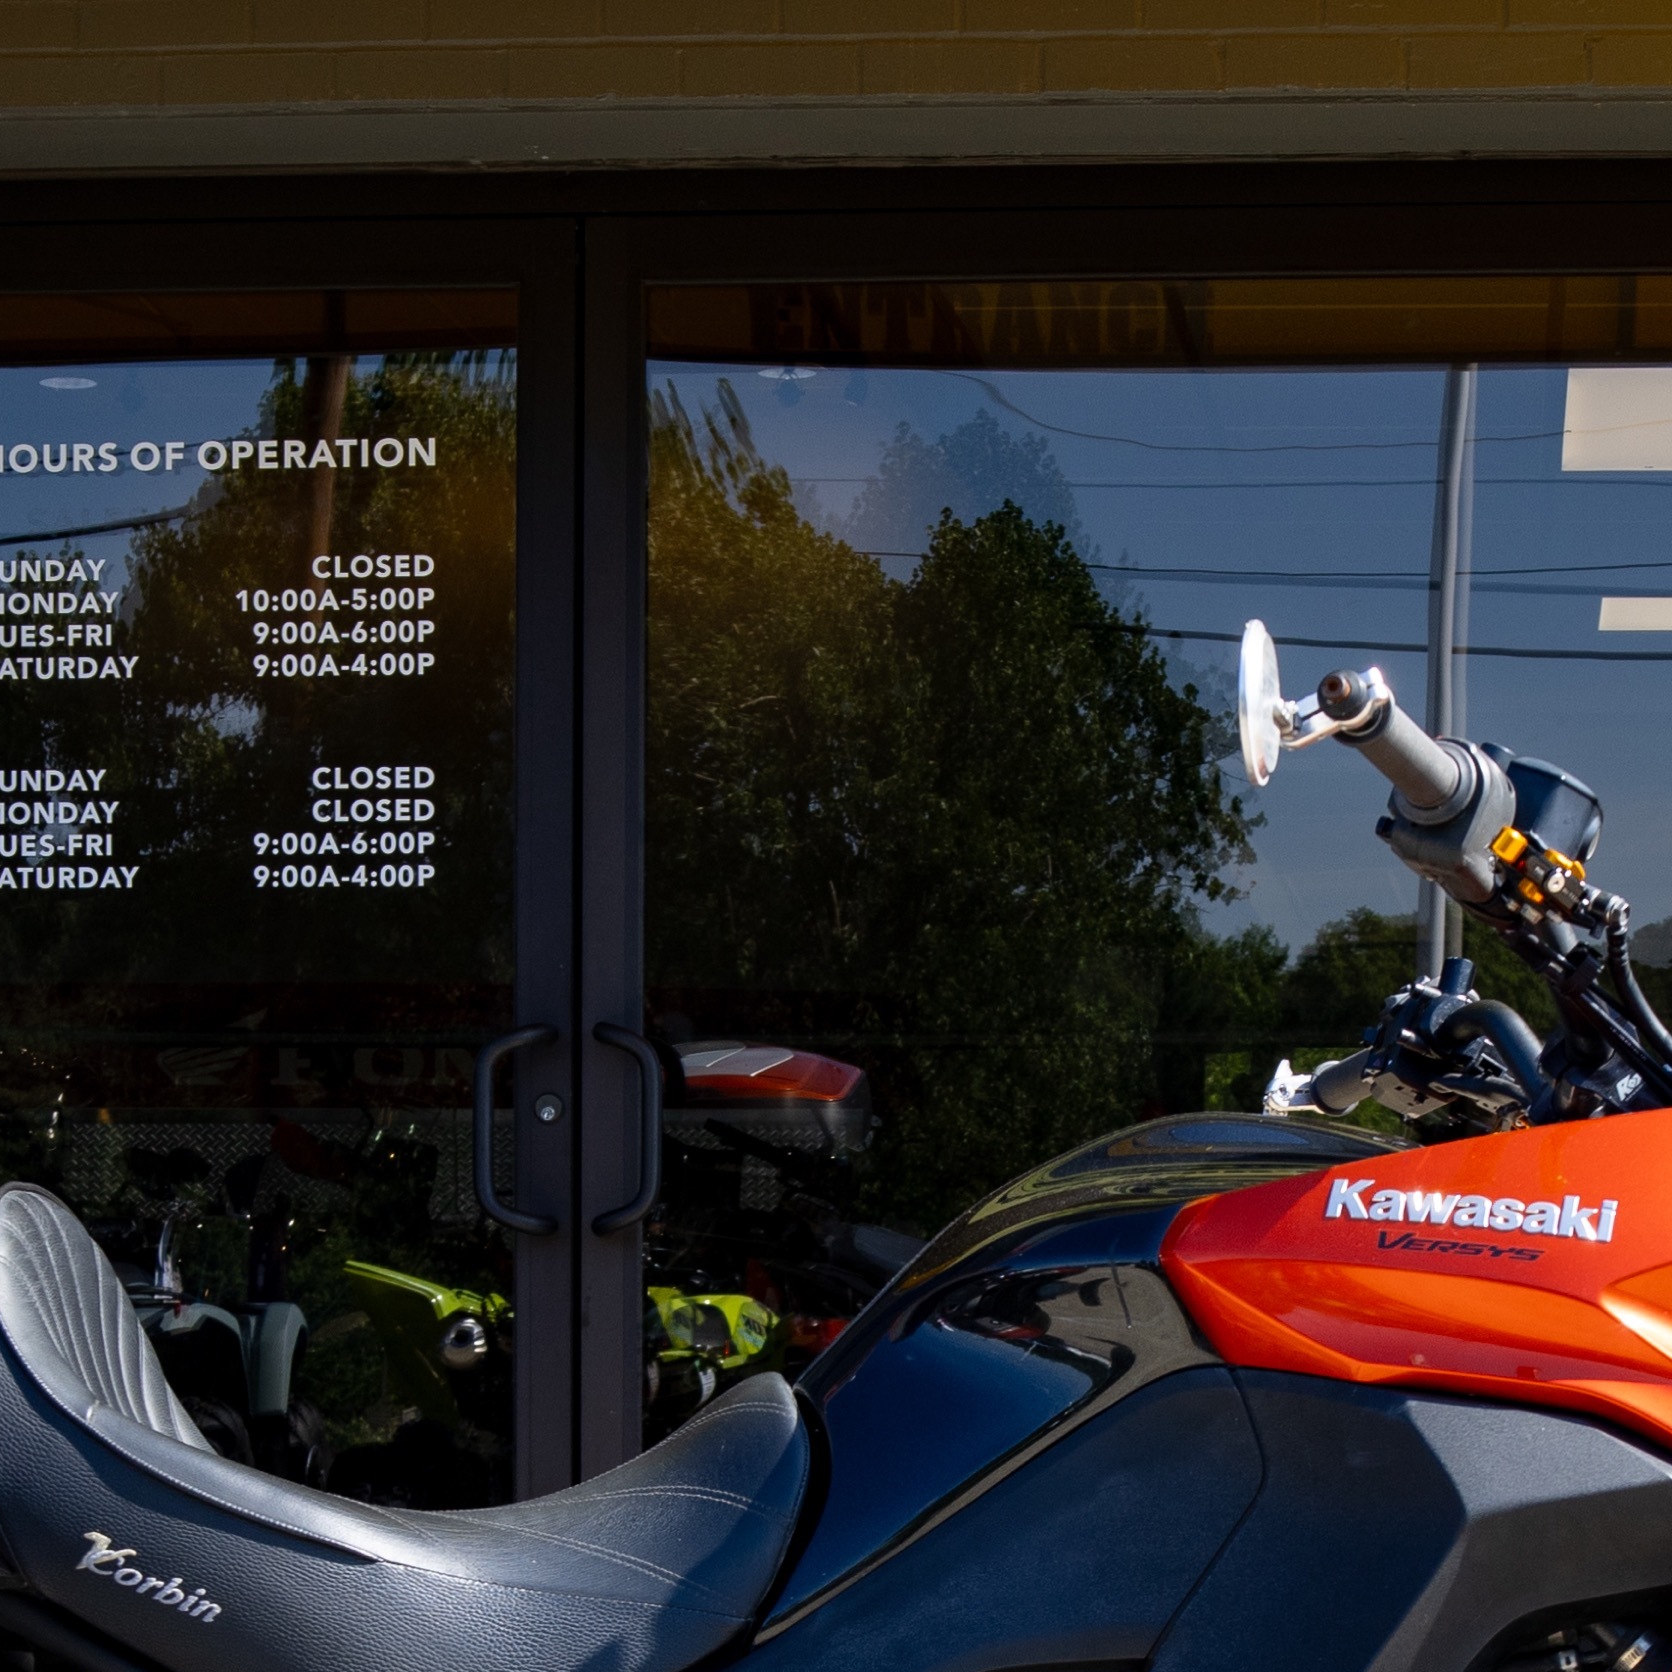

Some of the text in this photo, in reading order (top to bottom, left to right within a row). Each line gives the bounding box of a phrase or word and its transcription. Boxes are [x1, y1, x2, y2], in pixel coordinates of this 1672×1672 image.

[130, 441, 185, 472] OF
[197, 437, 436, 471] OPERATION
[312, 554, 435, 579] CLOSED
[235, 587, 435, 612] 10:00A-5:00P
[253, 619, 435, 645] 9:00A-6:00P
[253, 652, 435, 677] 9:00A-4:00P
[312, 766, 435, 790] CLOSED
[312, 798, 435, 823] CLOSED
[253, 831, 435, 855] 9:00A-6:00P
[253, 864, 435, 888] 9:00A-4:00P
[1325, 1178, 1619, 1243] Kawasaki
[1378, 1230, 1546, 1262] VERSYS
